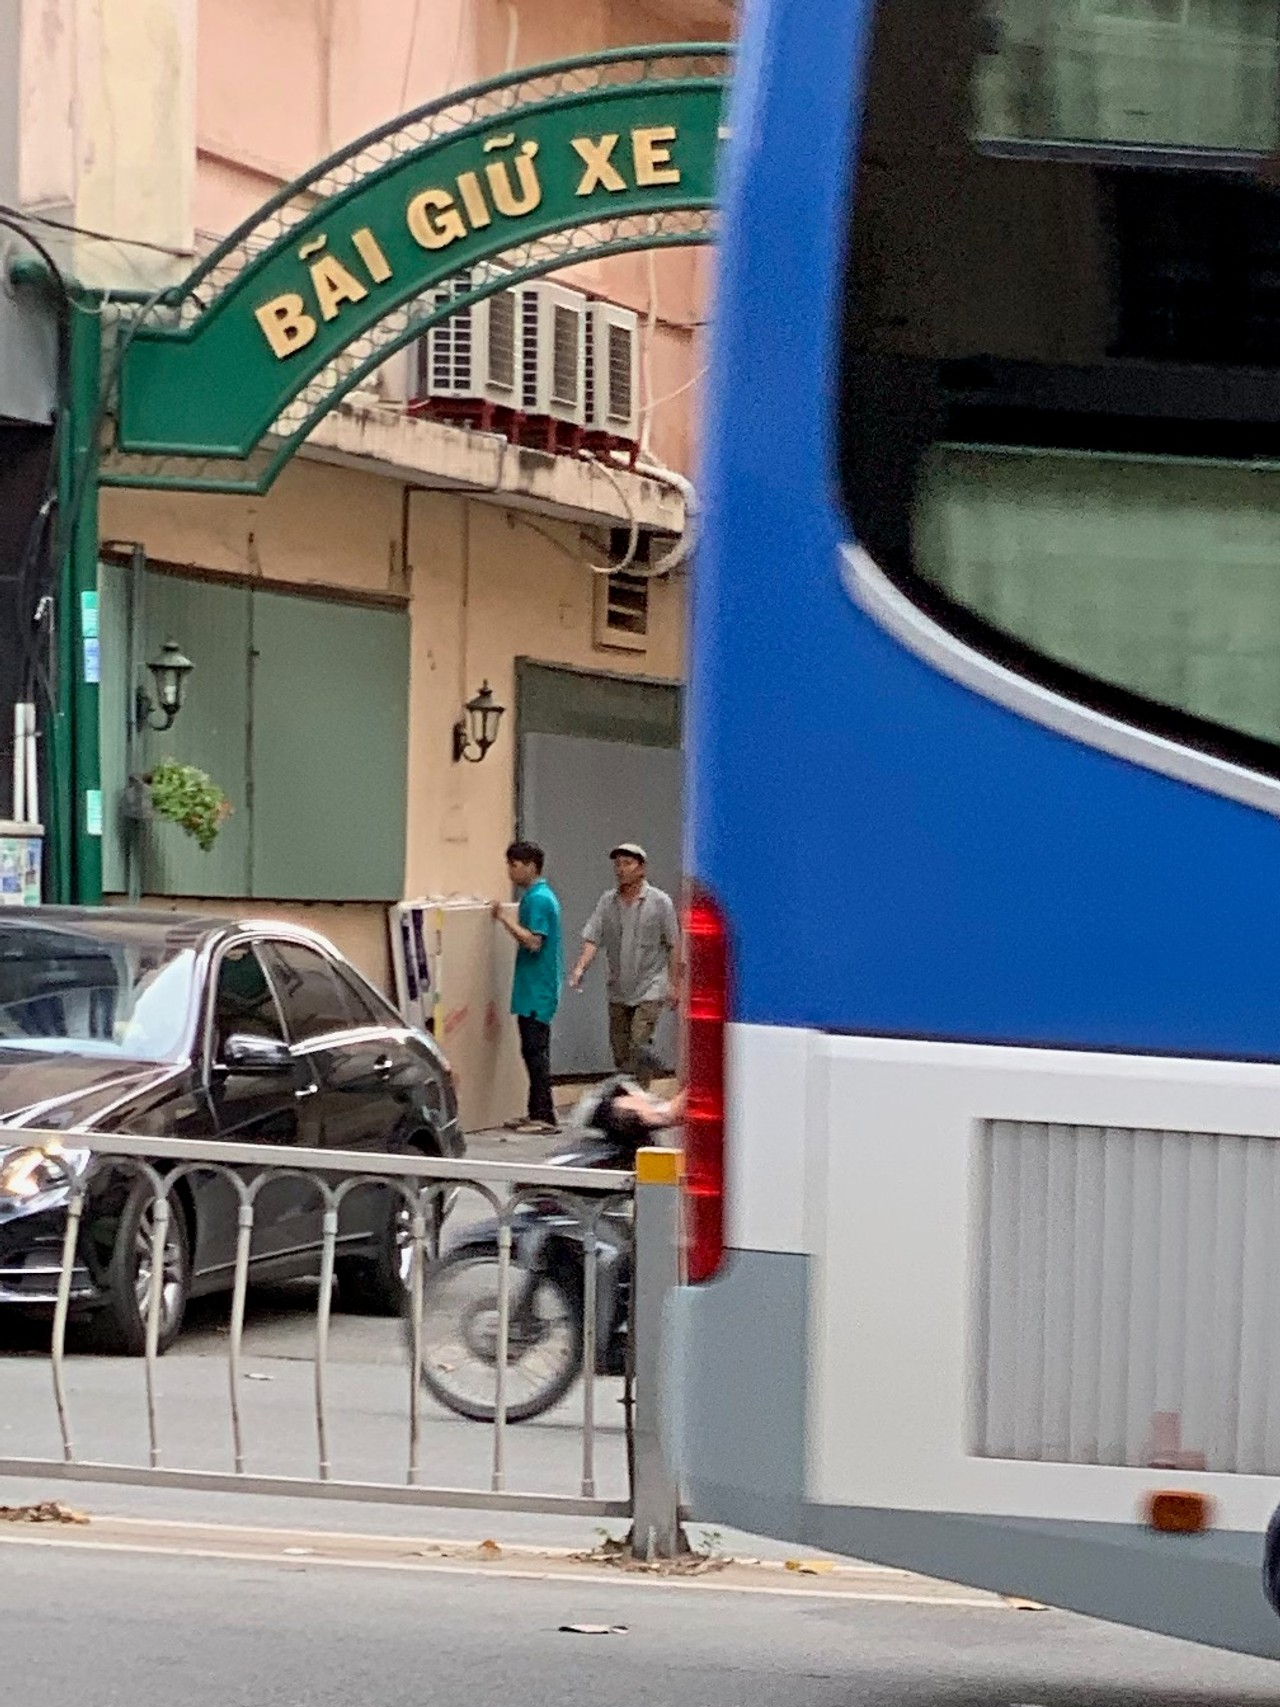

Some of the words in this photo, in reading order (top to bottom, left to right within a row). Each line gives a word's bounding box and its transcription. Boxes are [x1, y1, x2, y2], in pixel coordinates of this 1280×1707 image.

[253, 234, 393, 361] BÃI
[406, 132, 543, 250] GIỮ
[570, 125, 682, 198] XE
